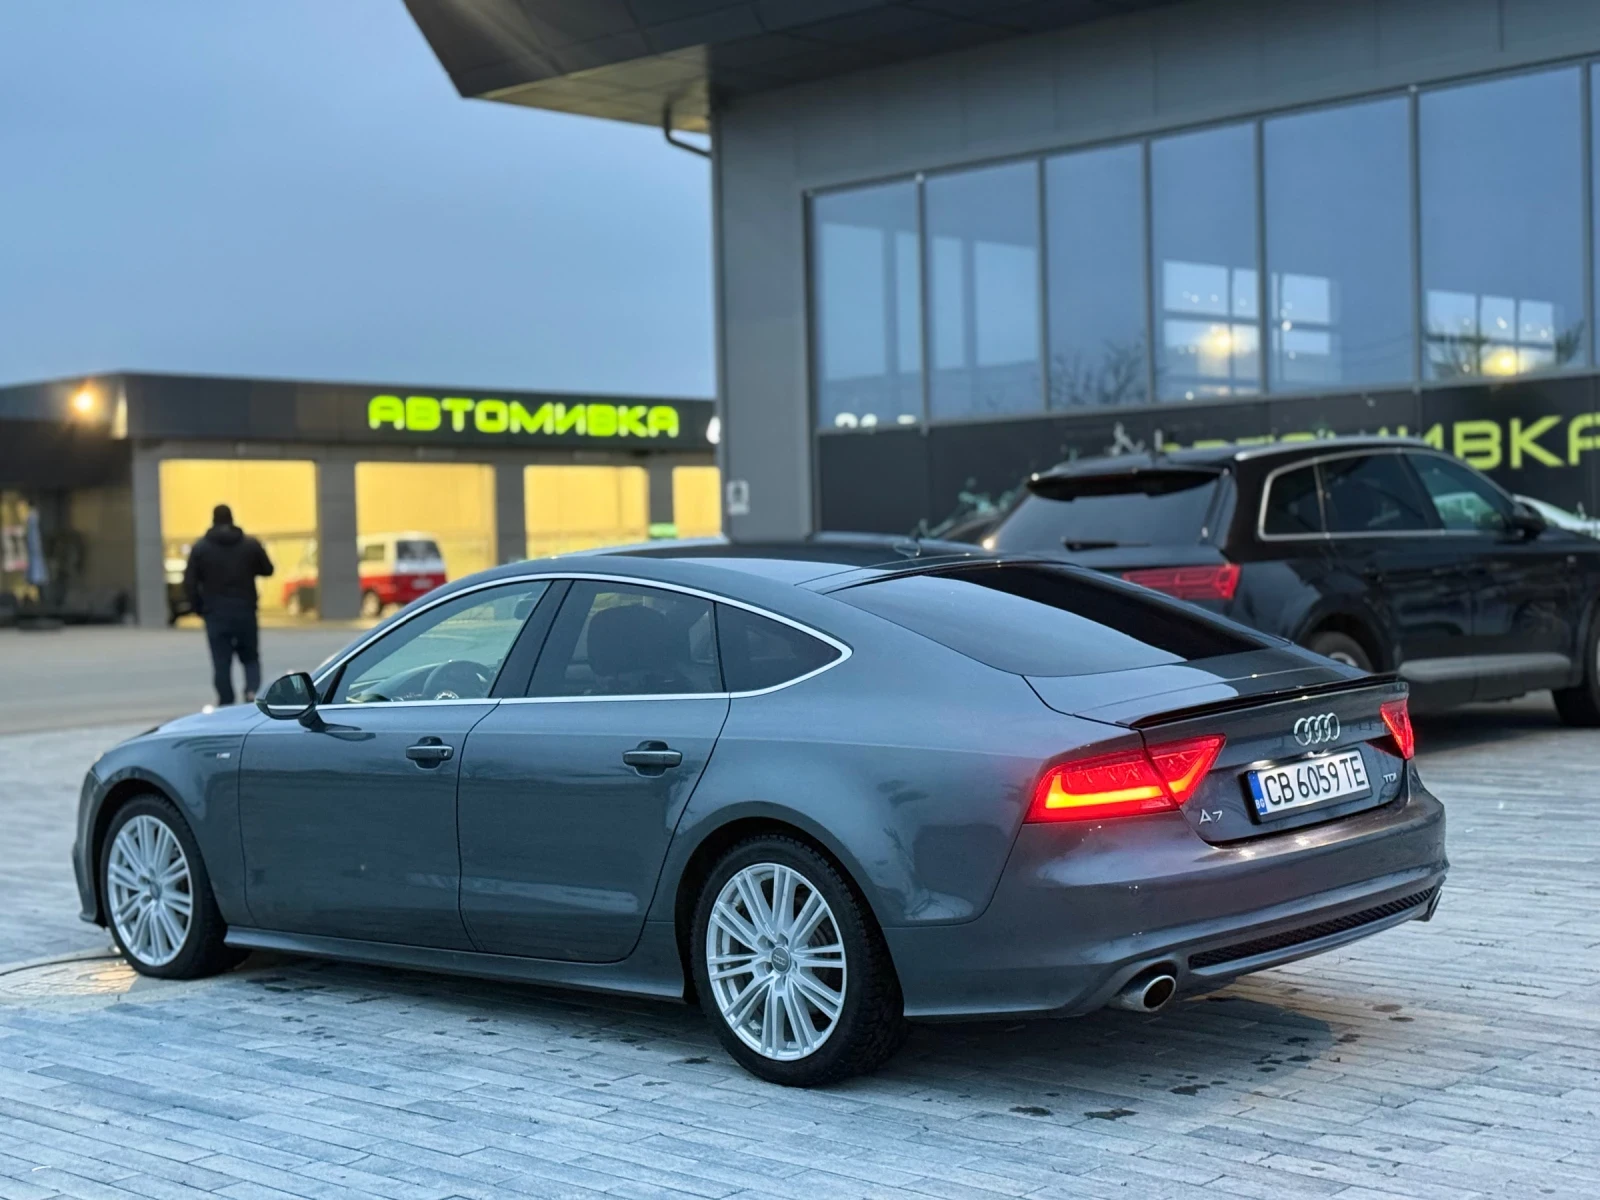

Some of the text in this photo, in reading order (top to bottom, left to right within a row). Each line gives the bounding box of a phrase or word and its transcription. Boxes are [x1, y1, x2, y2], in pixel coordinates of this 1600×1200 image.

[368, 395, 679, 438] АВТОМИВКА
[1297, 761, 1341, 798] 6059
[1340, 756, 1365, 788] TE
[1199, 808, 1223, 825] A7
[1255, 799, 1265, 809] BG
